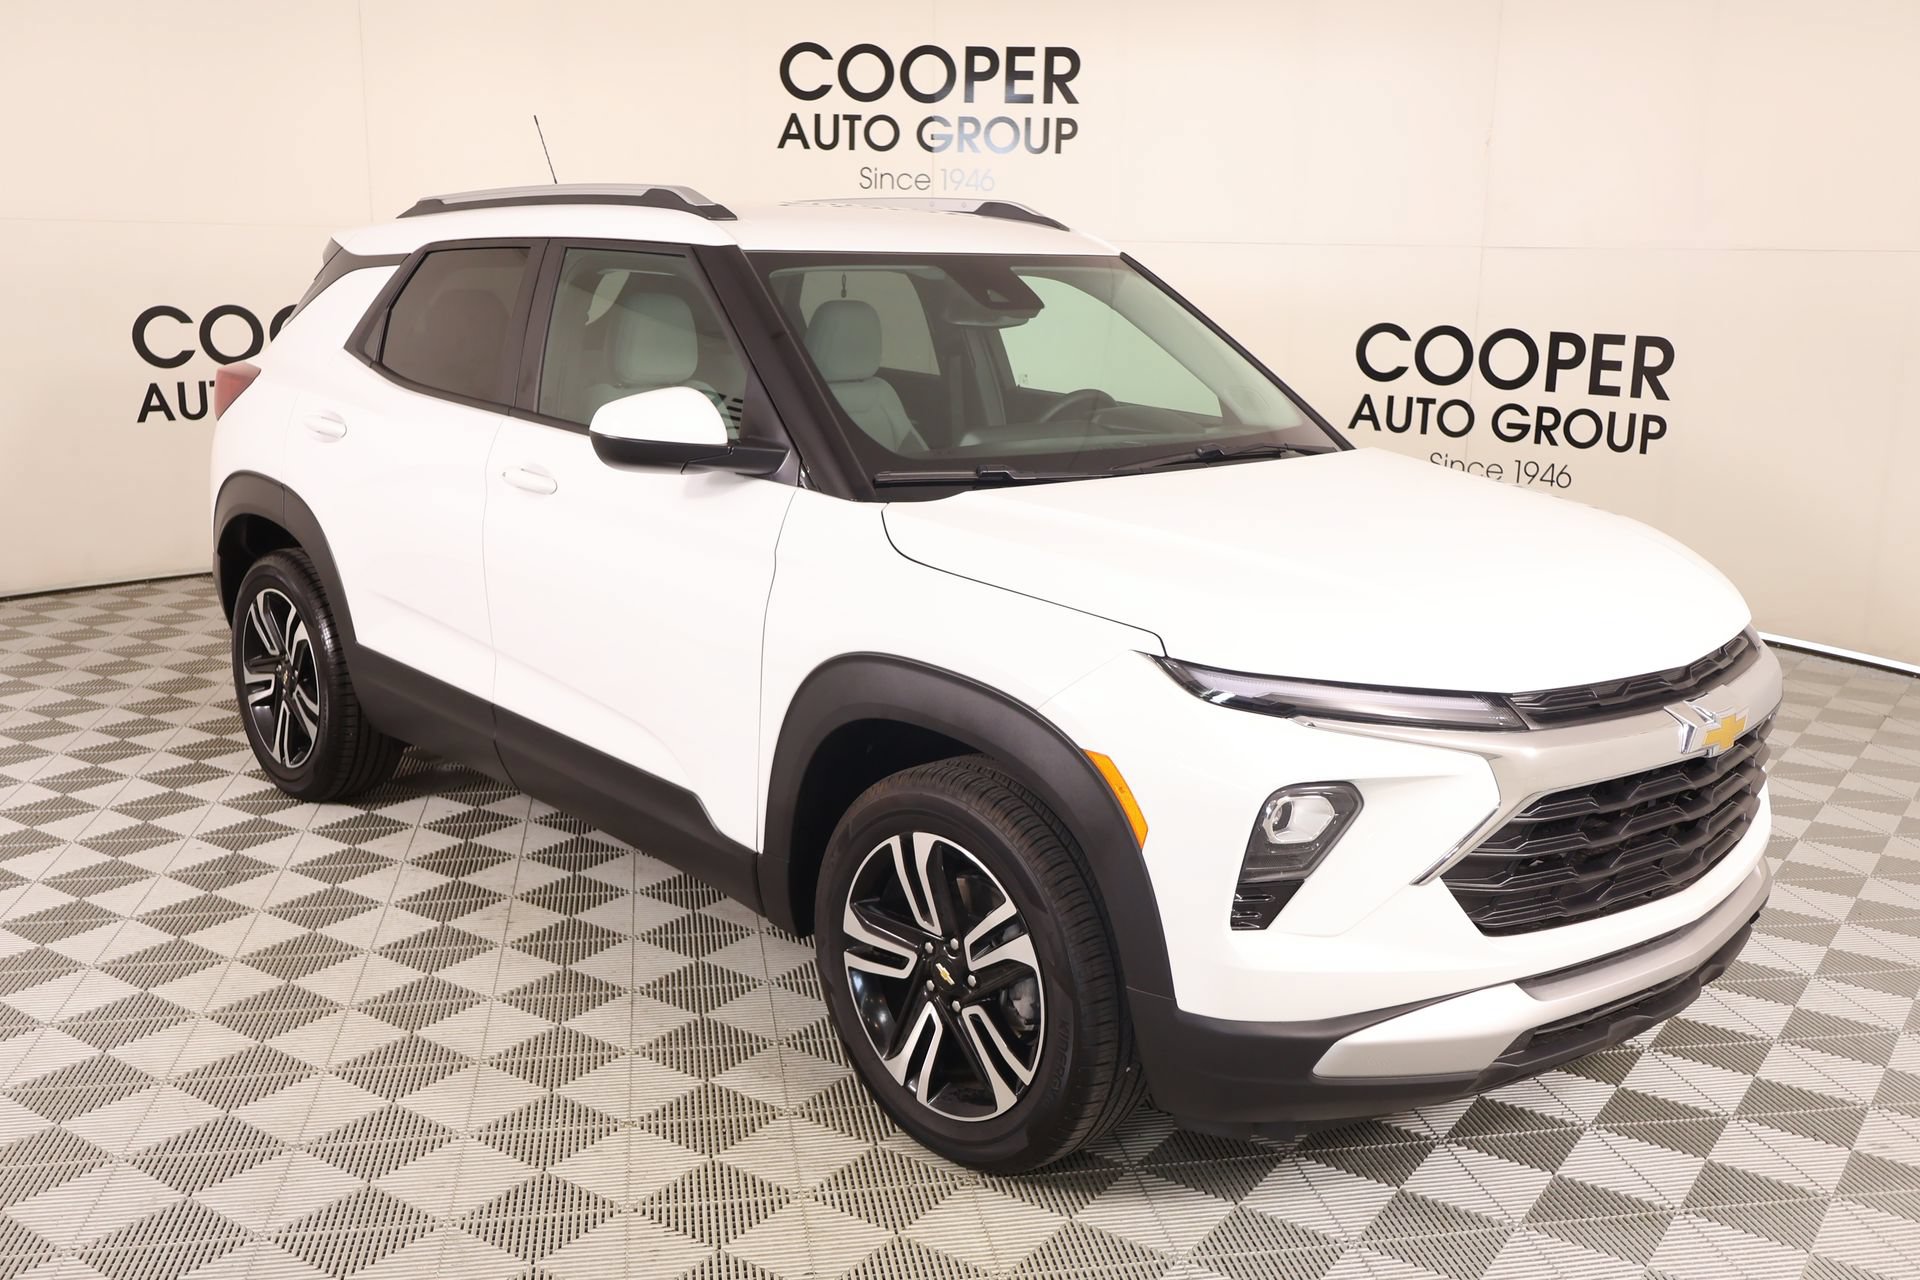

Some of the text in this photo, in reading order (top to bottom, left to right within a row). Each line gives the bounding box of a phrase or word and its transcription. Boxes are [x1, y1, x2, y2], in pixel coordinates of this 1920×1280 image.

[779, 41, 1081, 104] COOPER
[777, 112, 1079, 155] AUTO GROUP
[859, 166, 996, 192] Since 1946
[1355, 322, 1676, 401] COOPER
[1348, 393, 1668, 455] AUTO GROUP
[1514, 459, 1572, 488] 1946
